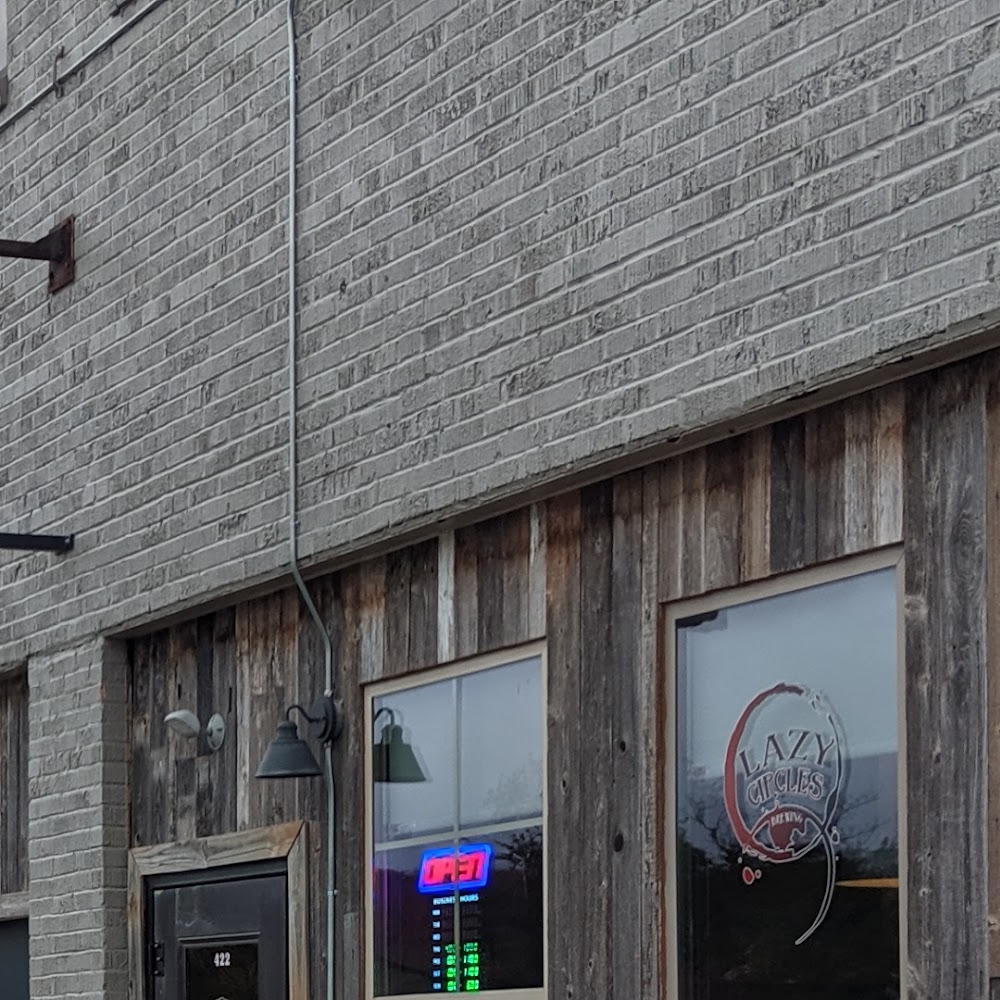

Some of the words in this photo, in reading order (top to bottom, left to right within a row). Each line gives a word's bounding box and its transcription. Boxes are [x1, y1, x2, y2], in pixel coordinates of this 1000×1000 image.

[739, 728, 834, 778] LAZY
[746, 767, 825, 806] CIRCLES
[423, 852, 486, 885] OPEN
[214, 952, 231, 967] 422
